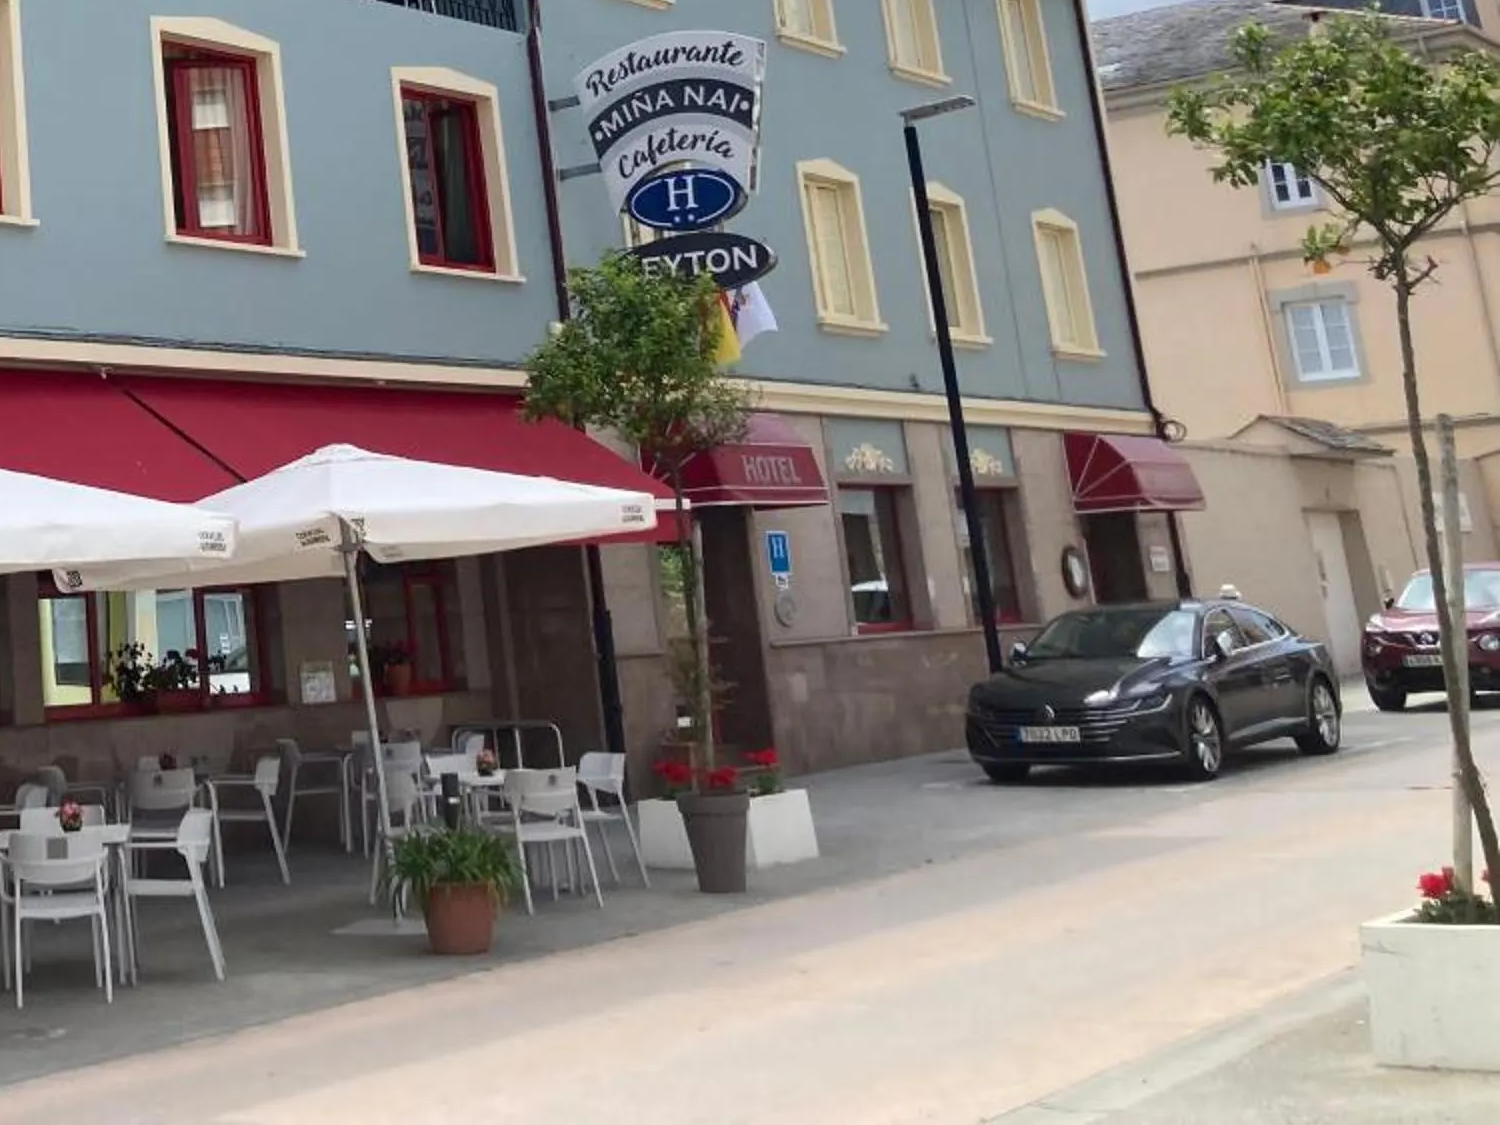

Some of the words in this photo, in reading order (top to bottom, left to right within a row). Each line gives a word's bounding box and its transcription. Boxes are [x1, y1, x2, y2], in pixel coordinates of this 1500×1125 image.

[586, 40, 745, 98] Restaurante
[602, 88, 675, 140] MIÑA
[683, 85, 738, 112] NAI
[618, 127, 736, 180] Cafetería
[664, 174, 699, 211] H
[640, 244, 757, 279] EYTON
[742, 454, 802, 486] HOTEL
[771, 536, 784, 558] H
